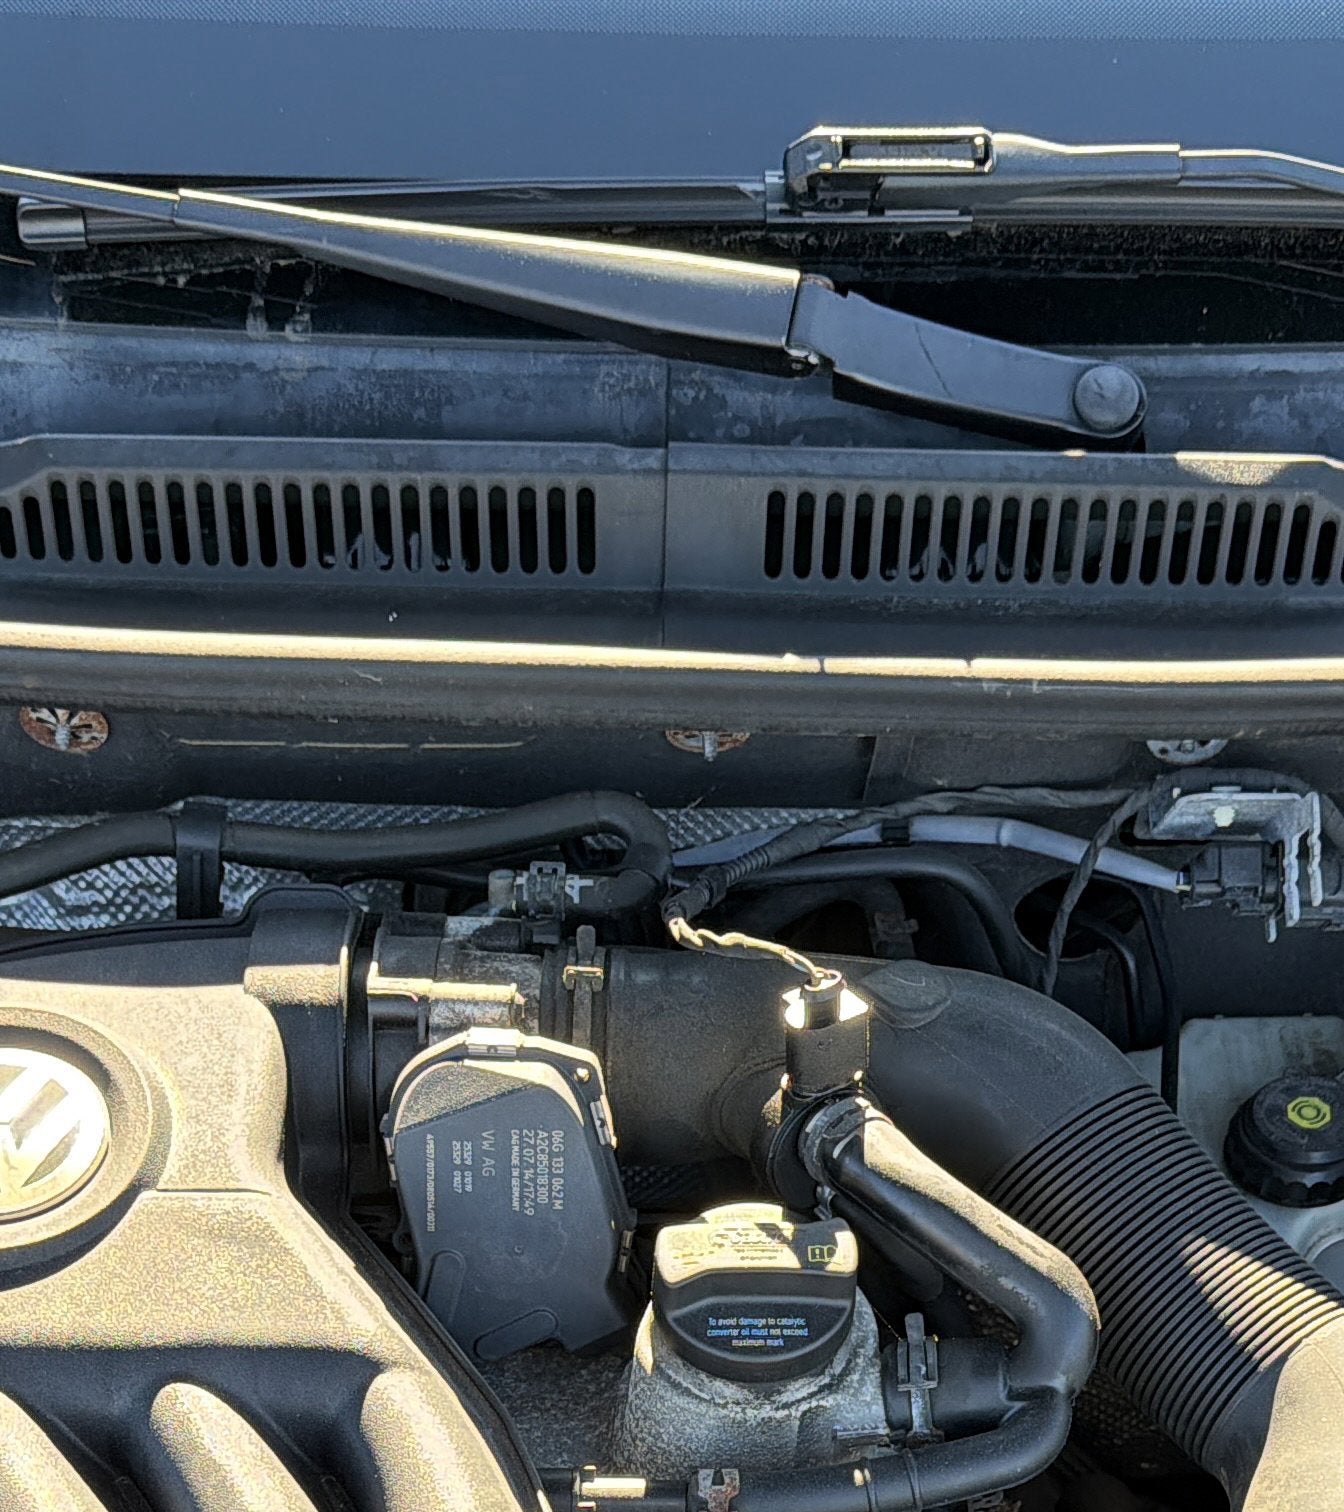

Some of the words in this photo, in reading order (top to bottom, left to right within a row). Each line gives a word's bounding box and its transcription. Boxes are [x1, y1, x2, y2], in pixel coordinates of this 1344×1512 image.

[482, 1130, 494, 1151] VW
[552, 1130, 564, 1152] 06G
[482, 1157, 495, 1176] AG
[552, 1157, 564, 1173] 133
[512, 1178, 520, 1211] GERMANY
[551, 1178, 564, 1197] 062
[718, 1317, 737, 1325] avoid
[739, 1318, 766, 1327] damage
[777, 1318, 806, 1327] catalytic
[707, 1328, 739, 1336] converter
